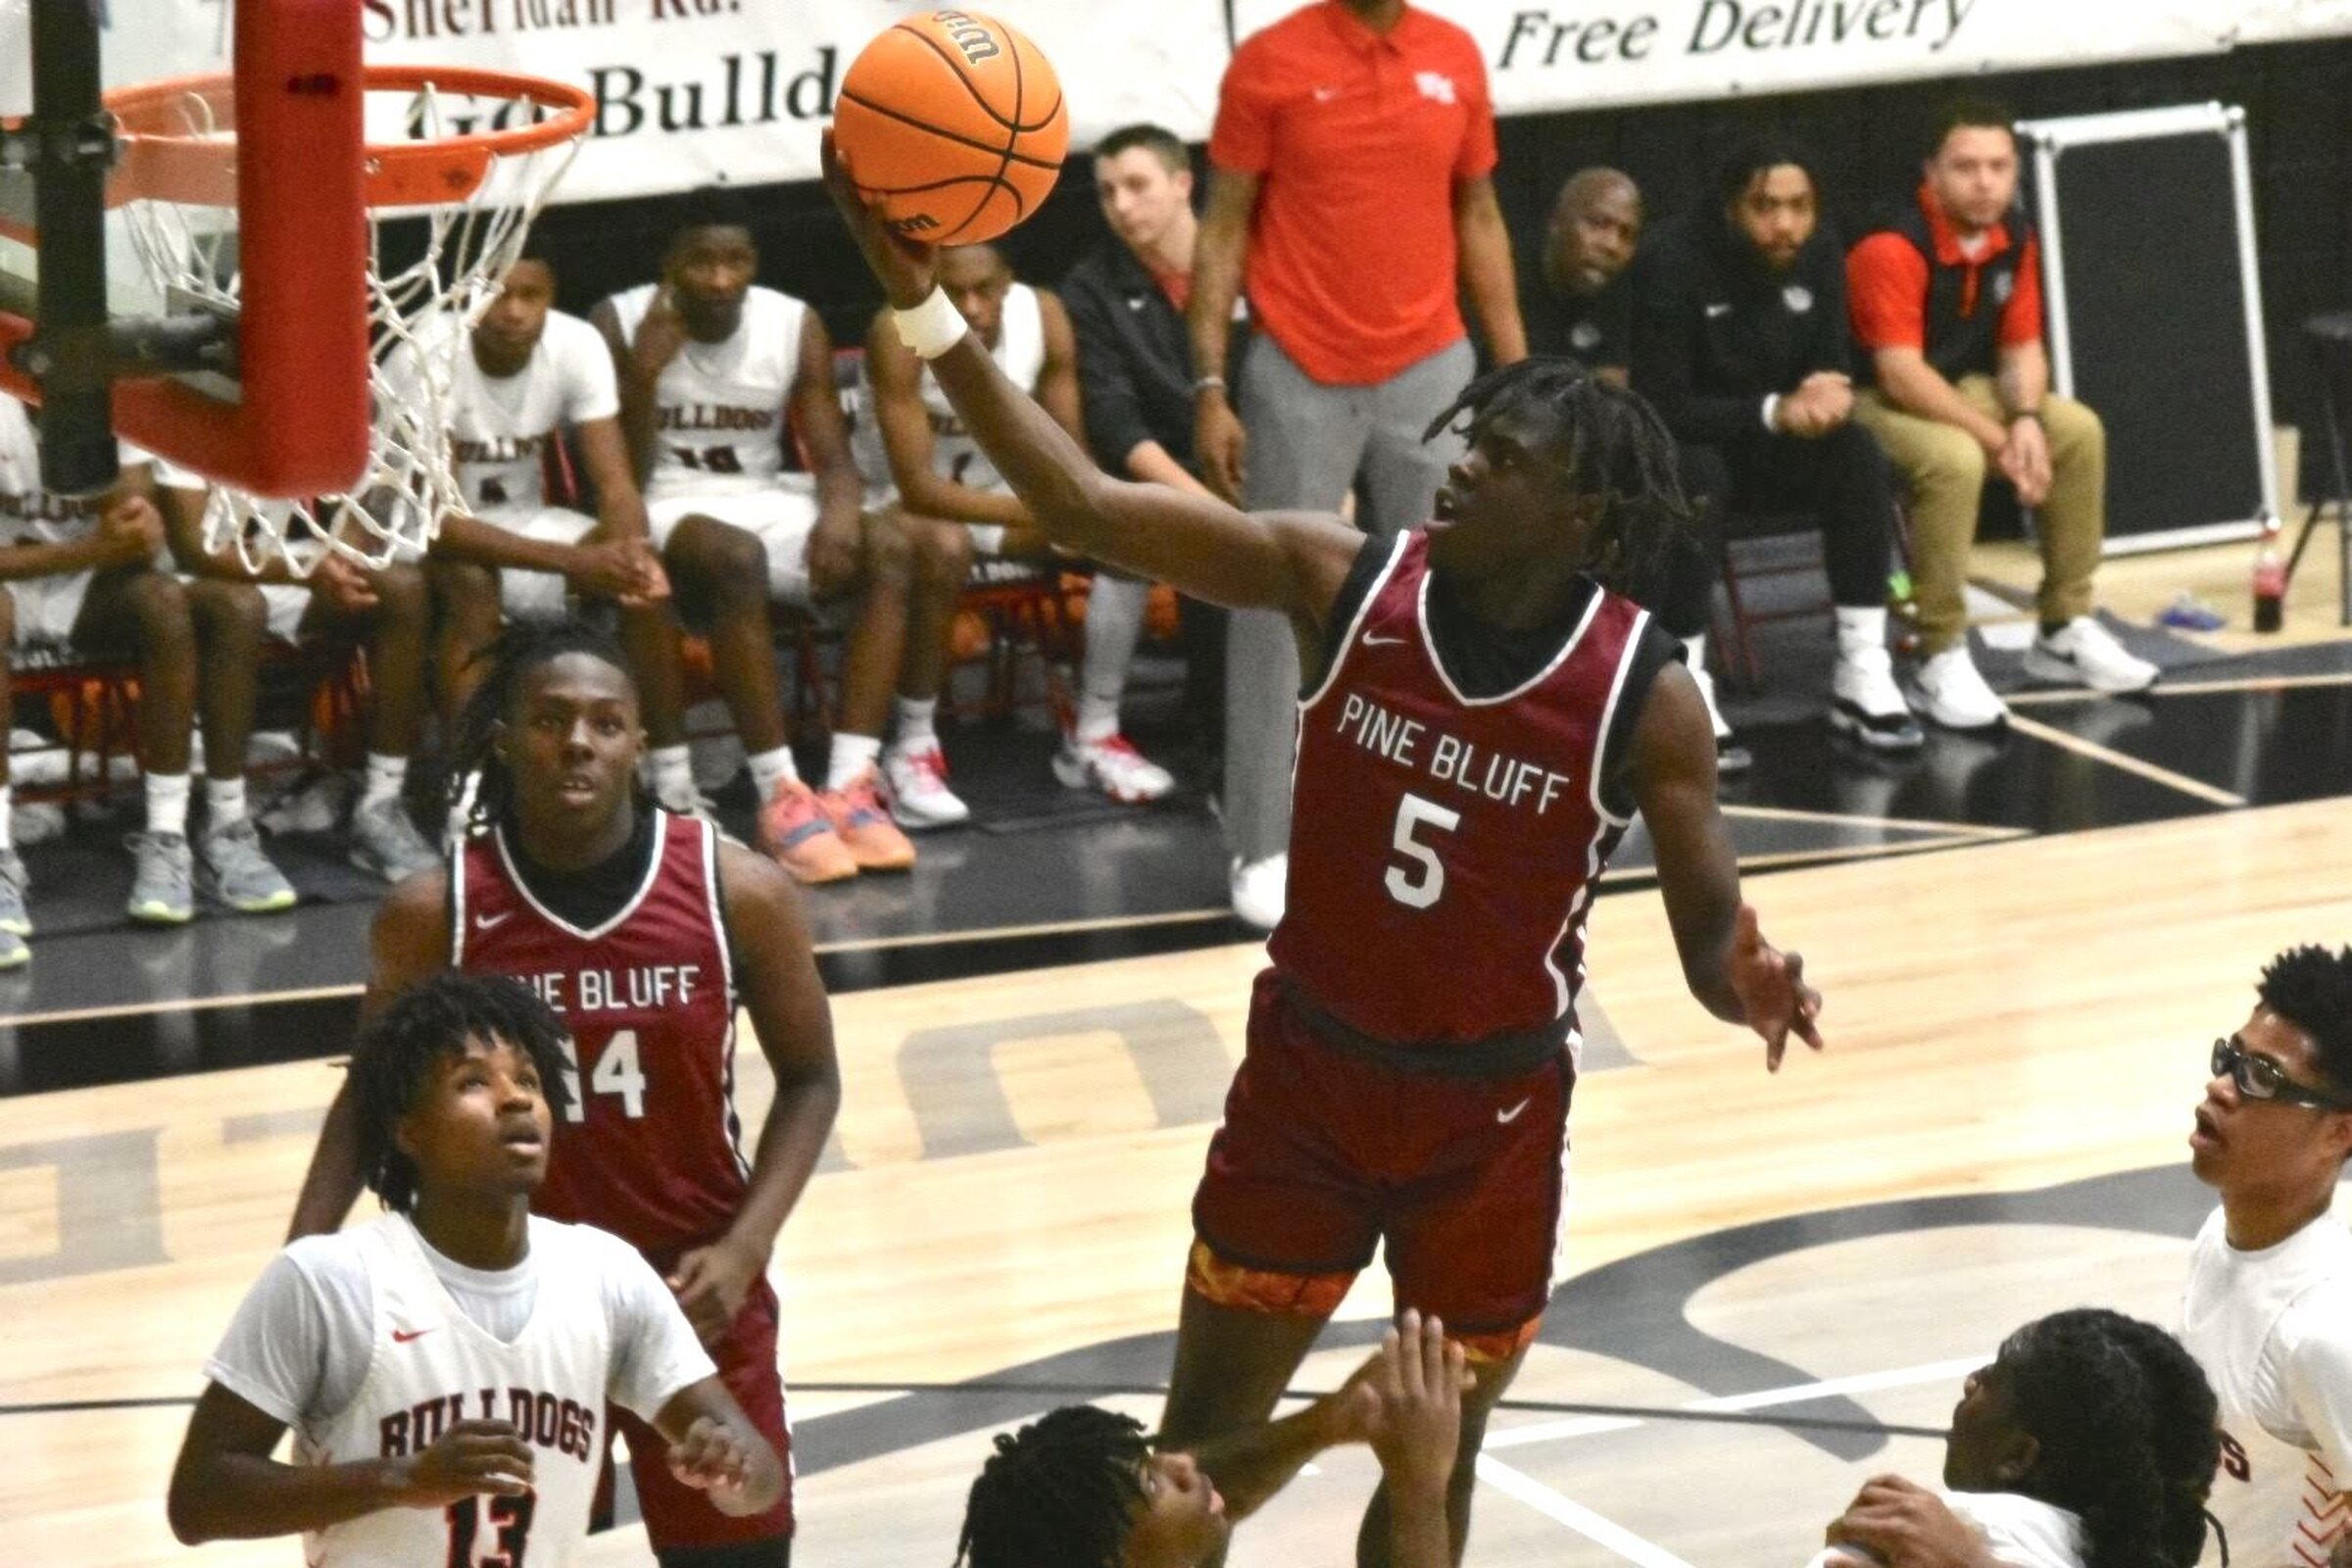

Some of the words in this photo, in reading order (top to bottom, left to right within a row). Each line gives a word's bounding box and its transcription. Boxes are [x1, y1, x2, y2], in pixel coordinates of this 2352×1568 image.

[1496, 9, 1658, 69] Free
[1686, 0, 1974, 53] Delivery
[1338, 695, 1425, 766] PINE
[1431, 734, 1569, 815] BLUFF
[1385, 793, 1460, 908] 5
[578, 964, 701, 1011] BLUFF
